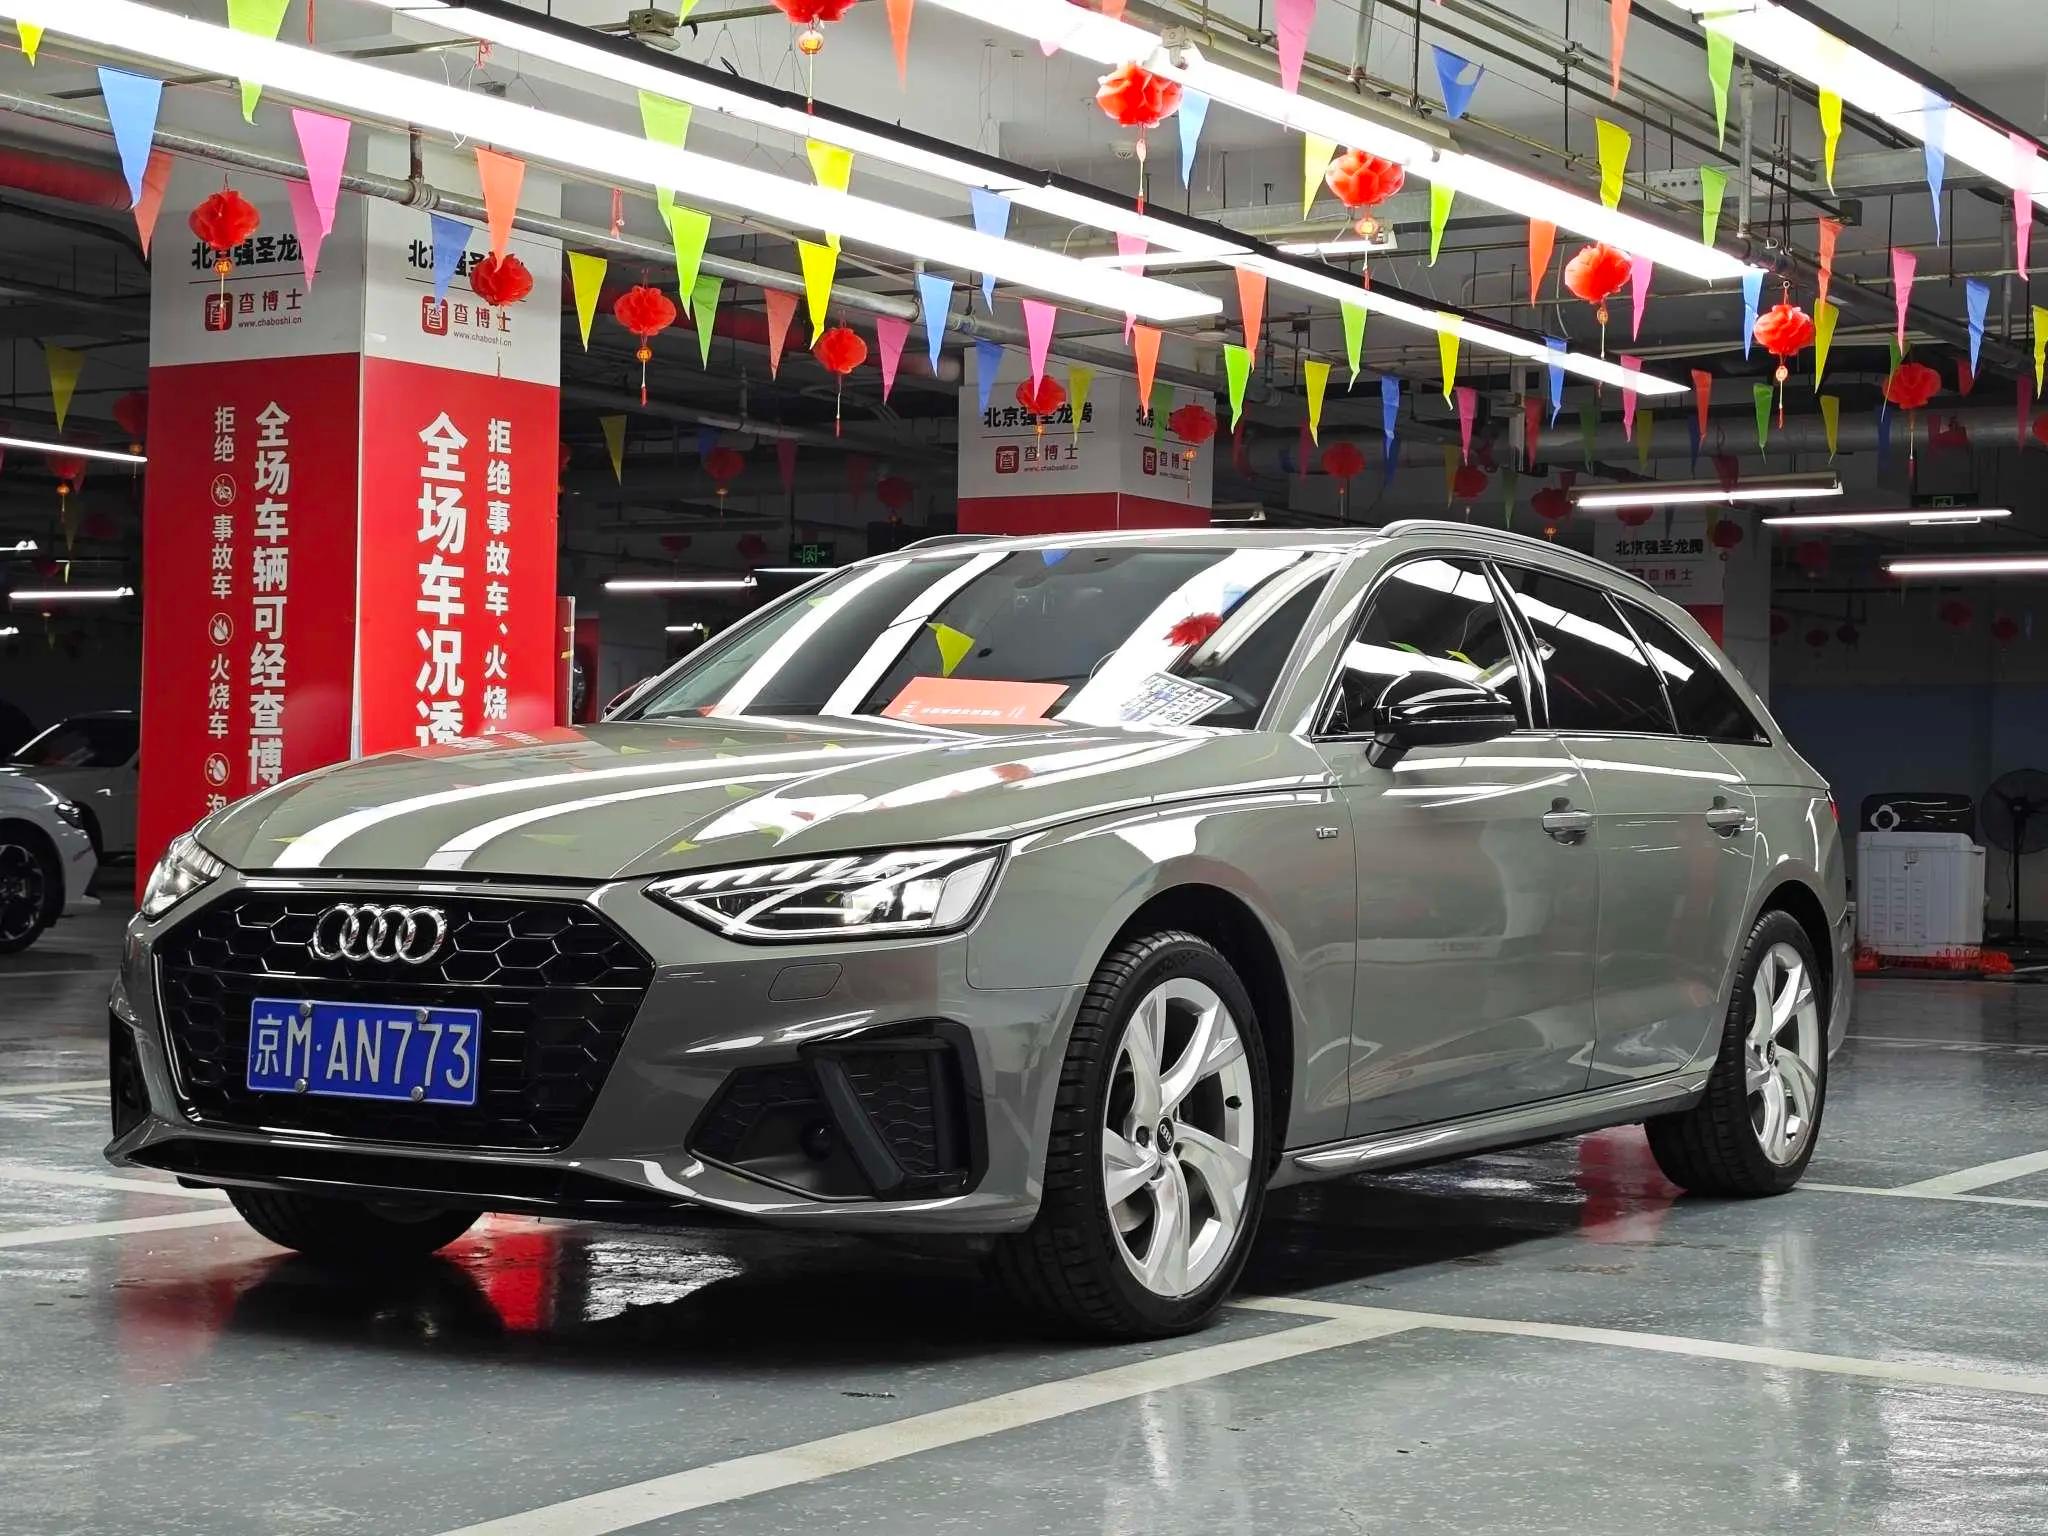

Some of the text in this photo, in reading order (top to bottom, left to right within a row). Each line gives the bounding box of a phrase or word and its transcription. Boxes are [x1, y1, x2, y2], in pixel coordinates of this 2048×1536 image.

[191, 233, 304, 270] 北强圣龙
[238, 288, 302, 314] 查博士
[239, 316, 302, 329] www.chaboshi.cn
[453, 304, 511, 332] 查博士
[453, 330, 512, 347] www.chaboshi.cn
[214, 406, 236, 462] 拒绝
[1024, 444, 1078, 462] 查博士
[211, 514, 233, 600] 事故车
[415, 411, 469, 746] 全场车况透
[482, 418, 512, 734] 拒绝事故车、火烧
[246, 401, 290, 788] 全场车辆可经查博
[206, 653, 231, 740] 火烧车
